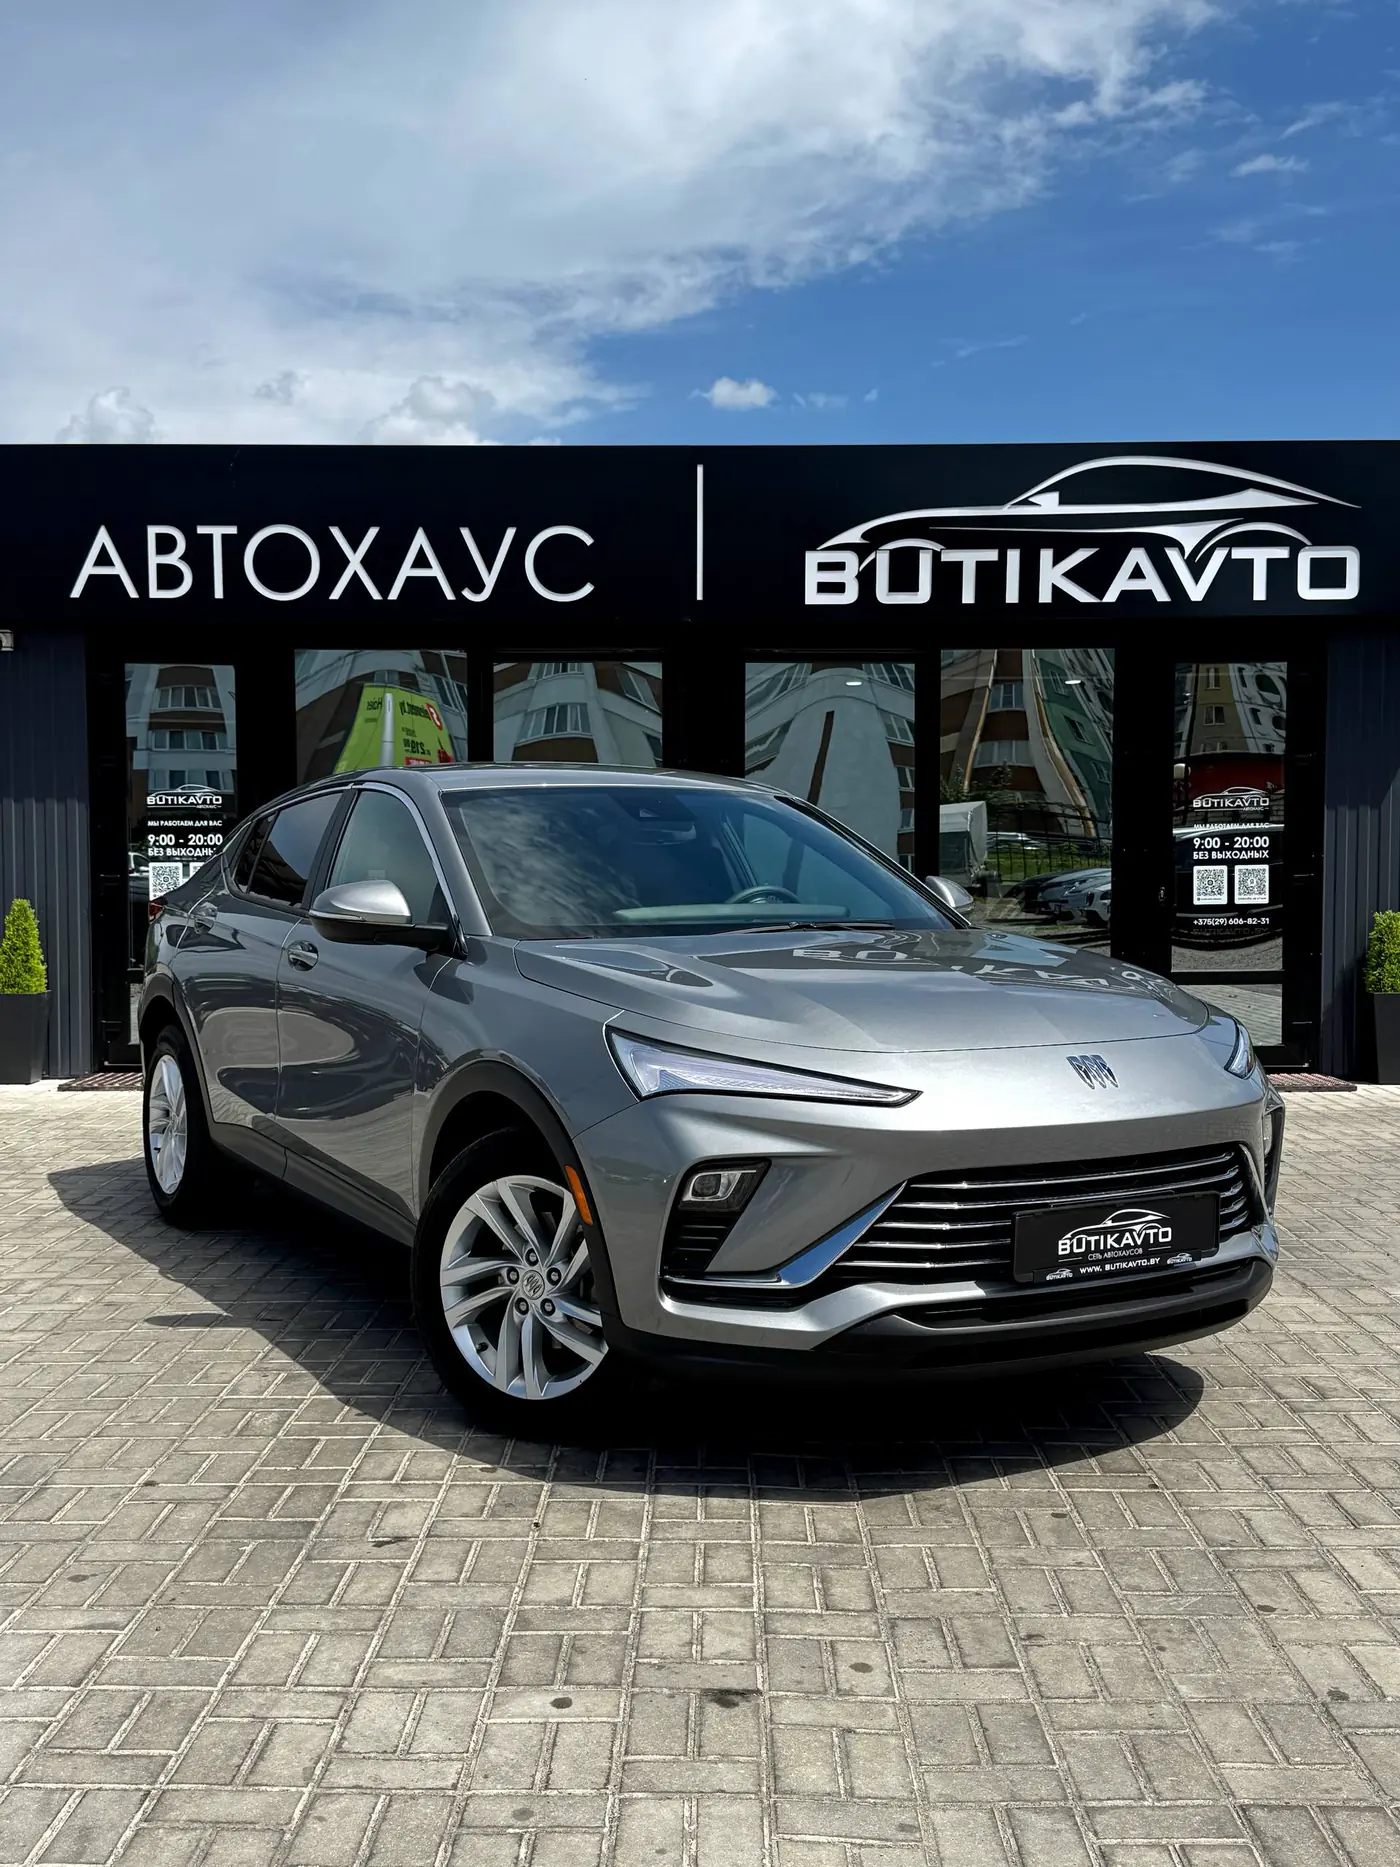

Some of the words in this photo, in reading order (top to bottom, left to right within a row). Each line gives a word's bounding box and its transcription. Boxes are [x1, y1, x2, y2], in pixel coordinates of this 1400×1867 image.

[69, 524, 595, 602] АВТОХАУС
[804, 544, 1361, 605] BUTIKAVTO
[147, 796, 222, 804] BUTIKAVTO
[1193, 798, 1269, 808] BUTIKAVTO
[147, 834, 176, 846] 9:00
[188, 834, 223, 846] 20:00
[1193, 837, 1220, 848] 9:00
[1233, 836, 1270, 848] 20:00
[148, 847, 164, 857] БЕЗ
[1193, 851, 1209, 860] БЕЗ
[1211, 850, 1270, 860] ВЫХОДНЫХ
[1193, 918, 1228, 926] +375(29)
[1058, 1227, 1172, 1255] BUTIKAVTO
[1087, 1253, 1103, 1261] СЕТЬ
[1103, 1248, 1142, 1258] АВТОХАУСОВ
[1079, 1265, 1103, 1274] WWW.
[1105, 1258, 1160, 1270] BUTIKAVTO.BY
